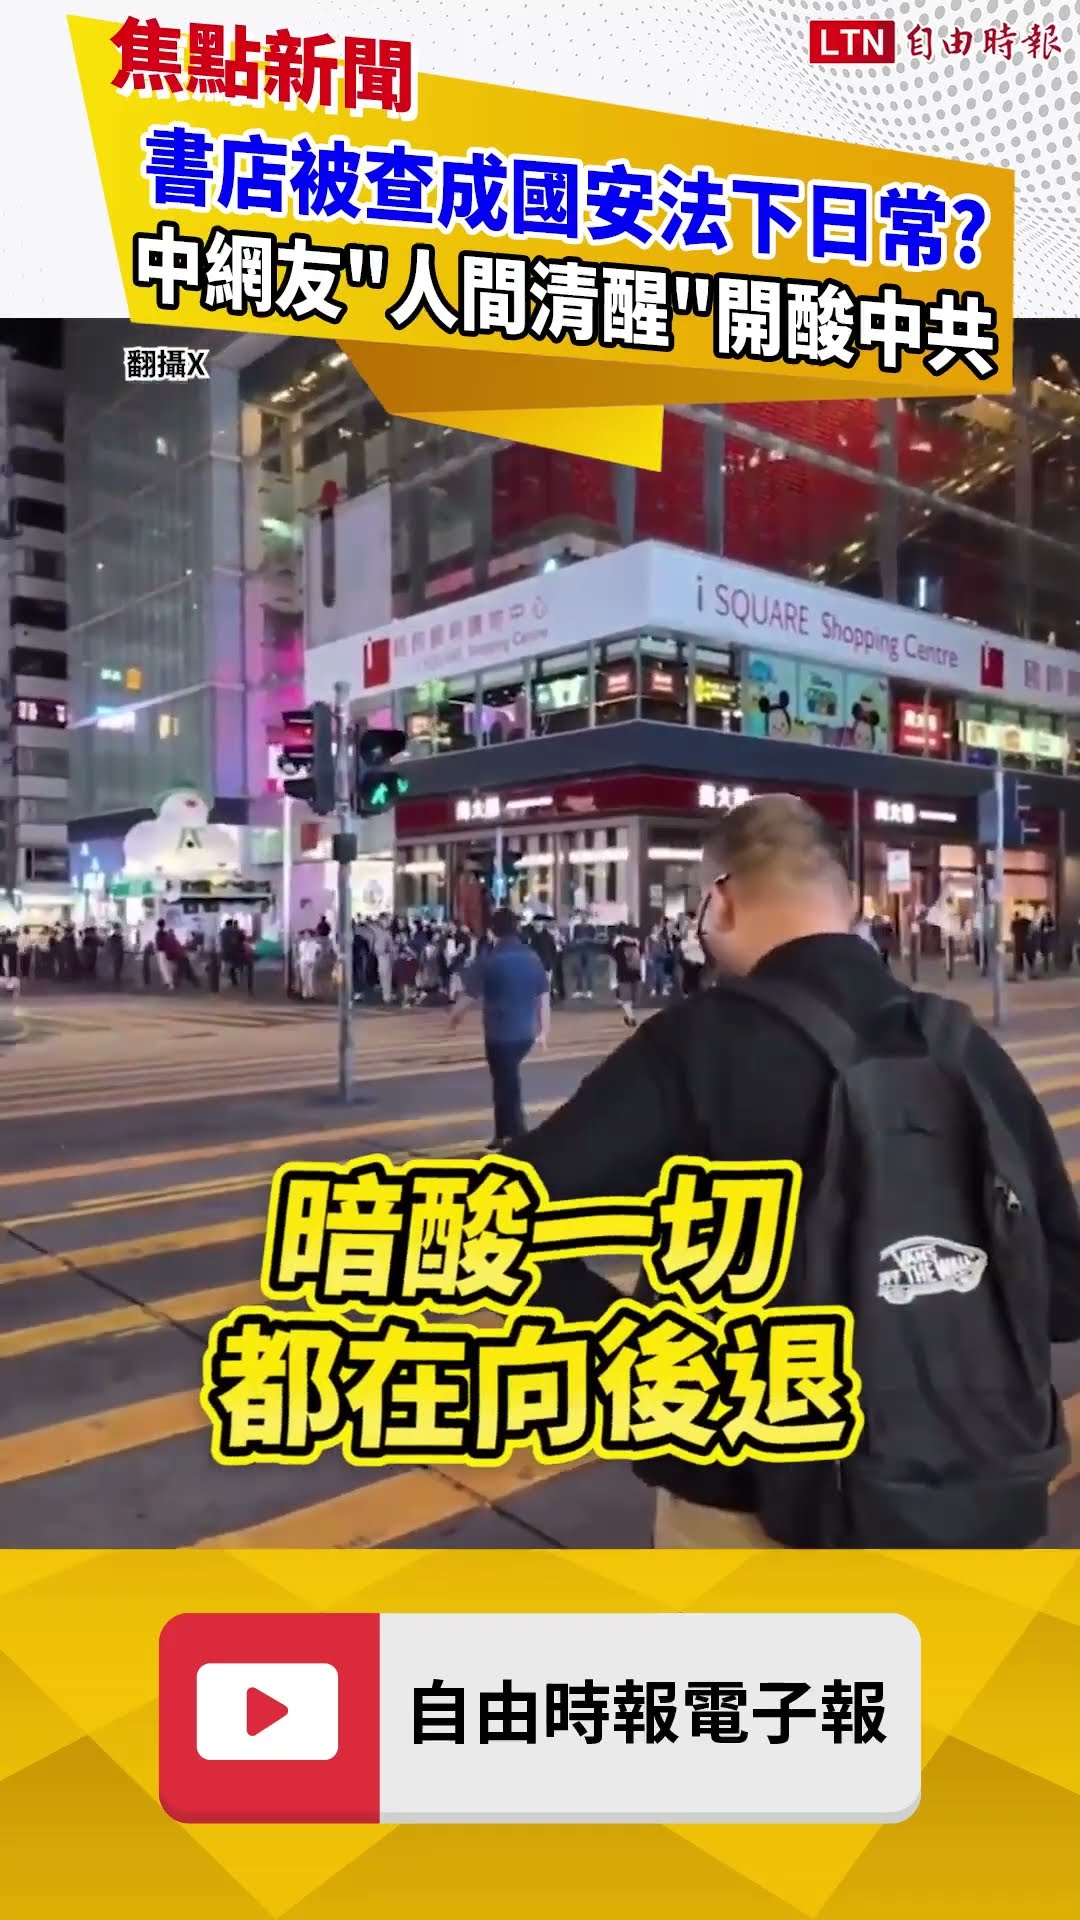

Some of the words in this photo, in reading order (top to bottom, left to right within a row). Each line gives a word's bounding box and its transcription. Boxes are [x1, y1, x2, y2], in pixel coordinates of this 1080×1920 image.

[715, 583, 809, 635] SQUARE
[821, 612, 899, 662] Shopping
[903, 633, 960, 668] Centre
